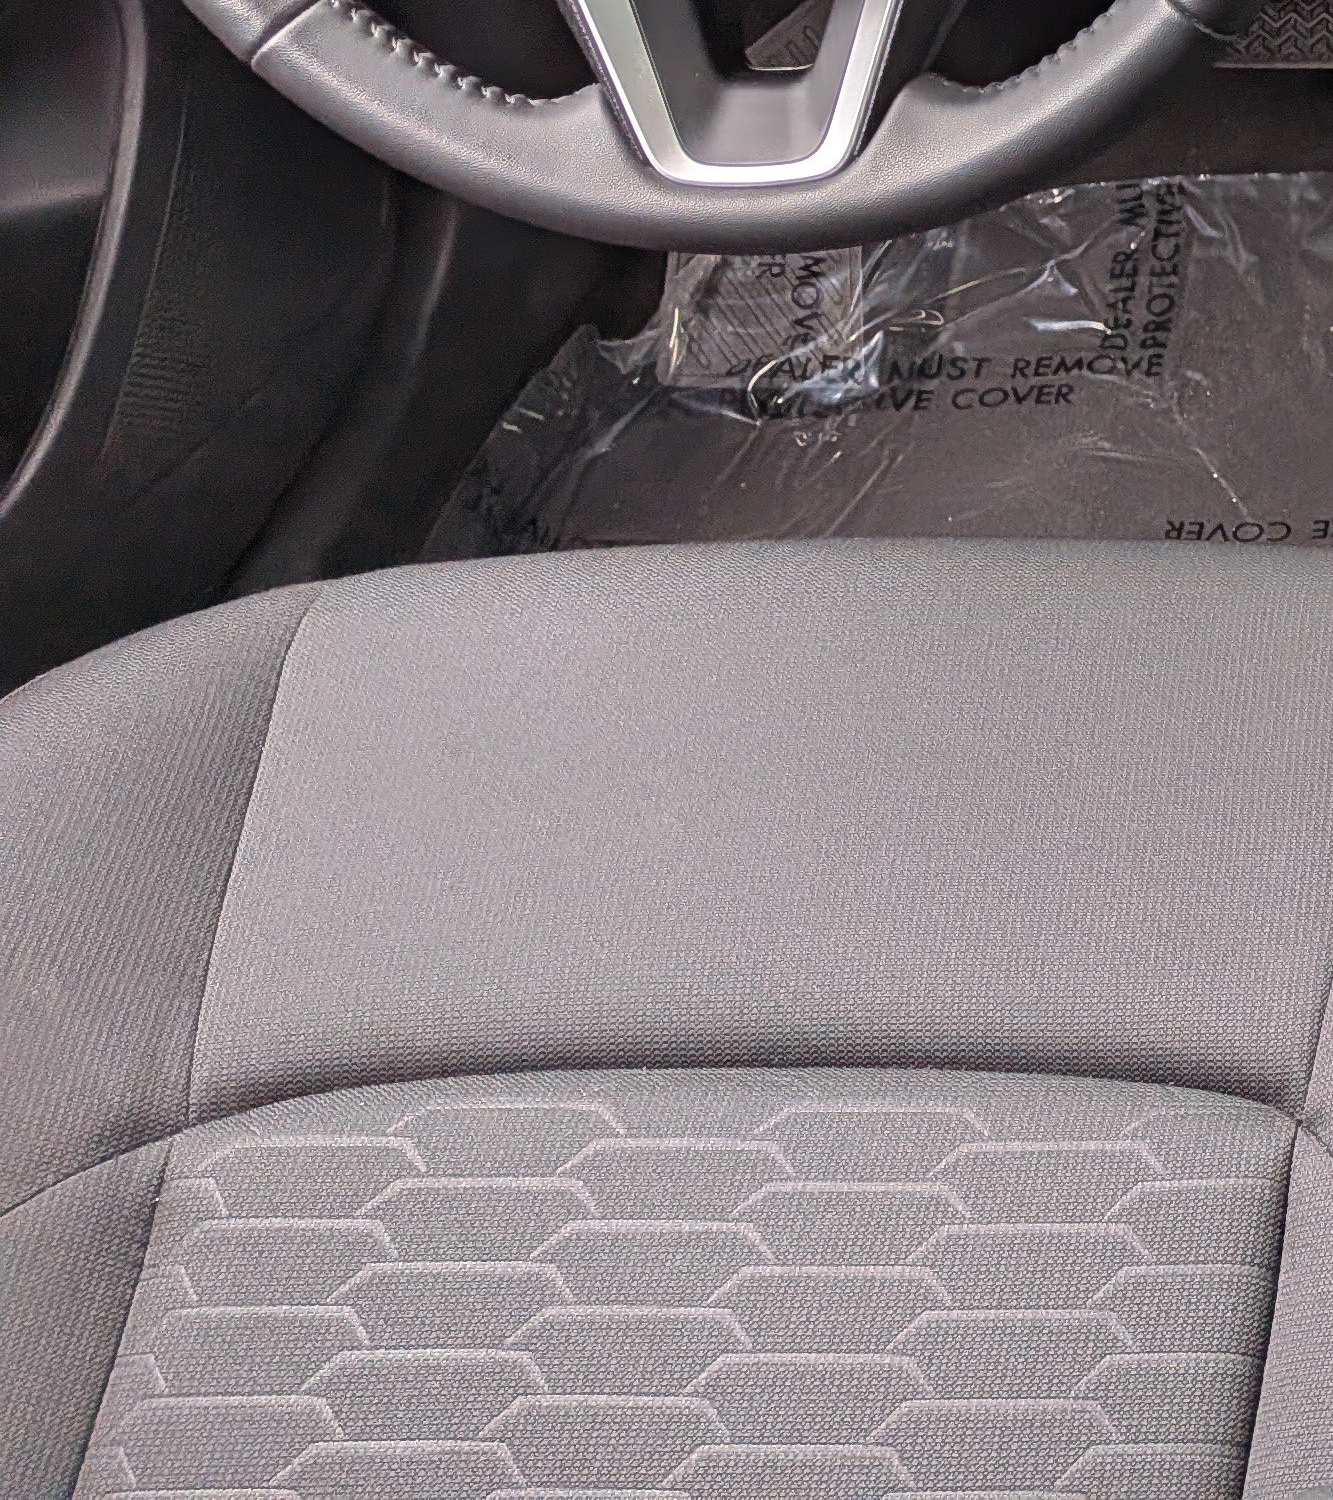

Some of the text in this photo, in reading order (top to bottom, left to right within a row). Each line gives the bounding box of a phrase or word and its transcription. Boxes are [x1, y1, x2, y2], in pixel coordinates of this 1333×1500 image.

[1100, 251, 1140, 350] DEALER
[890, 356, 988, 381] MUST
[1011, 353, 1165, 379] REMOVE
[951, 384, 1074, 411] COVER
[1165, 520, 1292, 543] COVER
